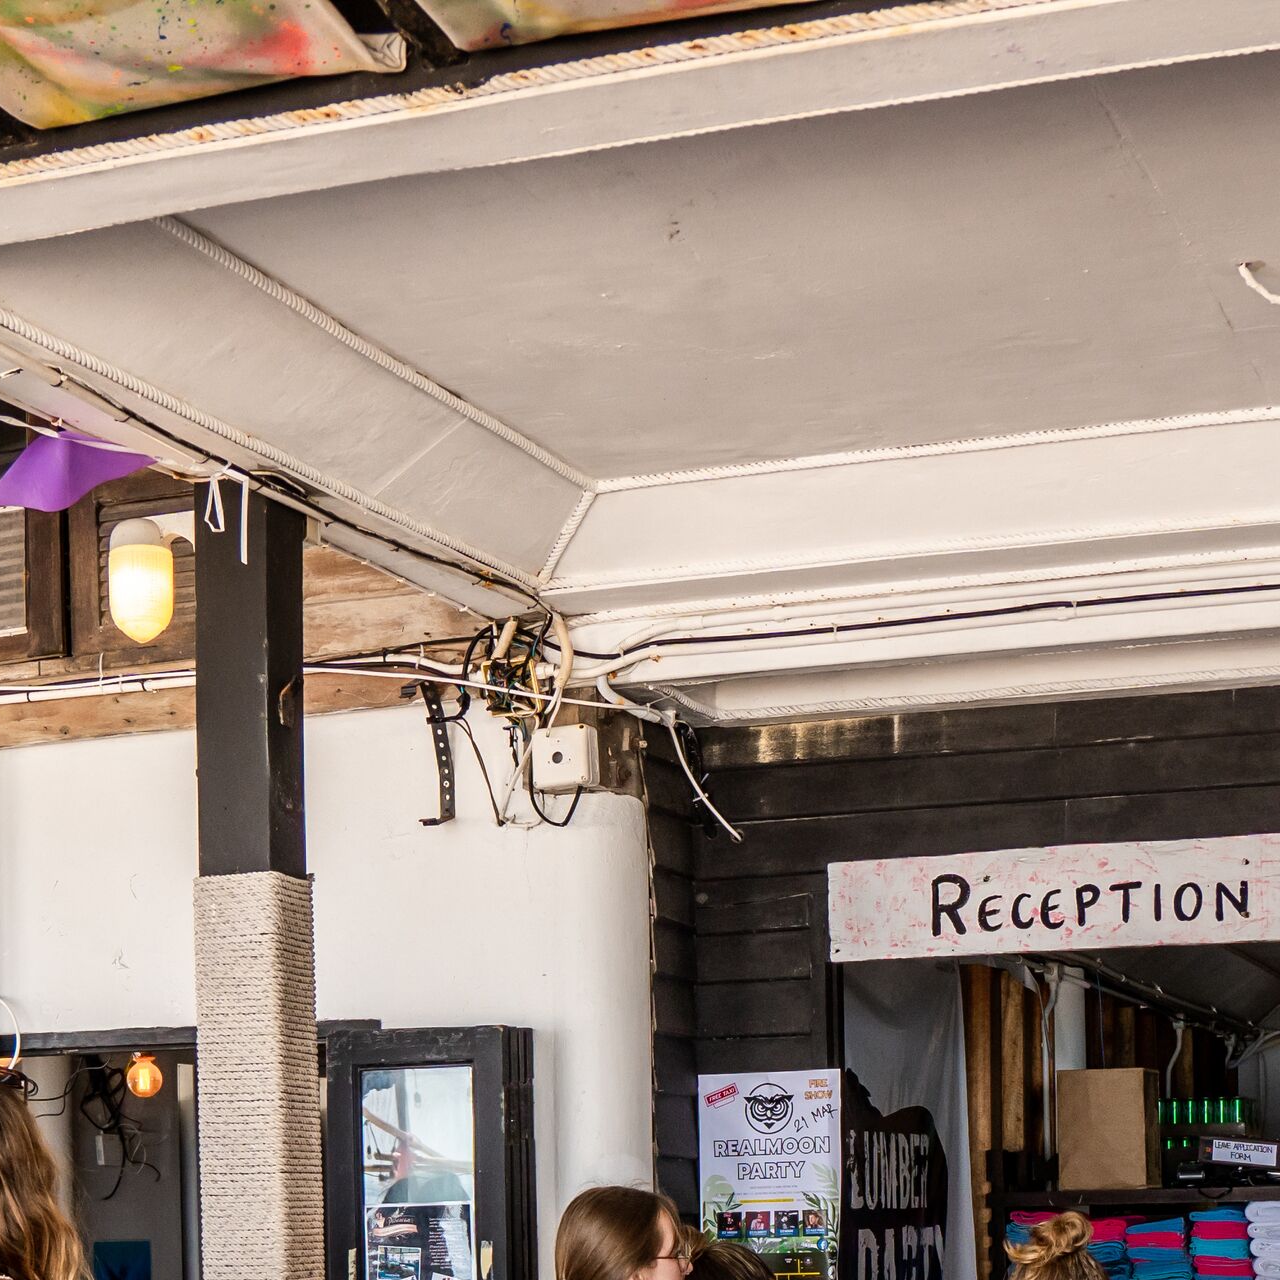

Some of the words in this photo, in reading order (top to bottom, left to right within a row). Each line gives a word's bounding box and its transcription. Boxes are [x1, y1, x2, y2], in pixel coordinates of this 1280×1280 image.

[929, 873, 1252, 938] RECEPTION
[808, 1078, 828, 1088] FIRE
[804, 1090, 833, 1100] SHOW
[793, 1115, 809, 1133] 21
[810, 1103, 838, 1123] MAR
[713, 1135, 831, 1157] REALMOON
[1230, 1151, 1252, 1162] FORM
[737, 1160, 806, 1180] PARTY
